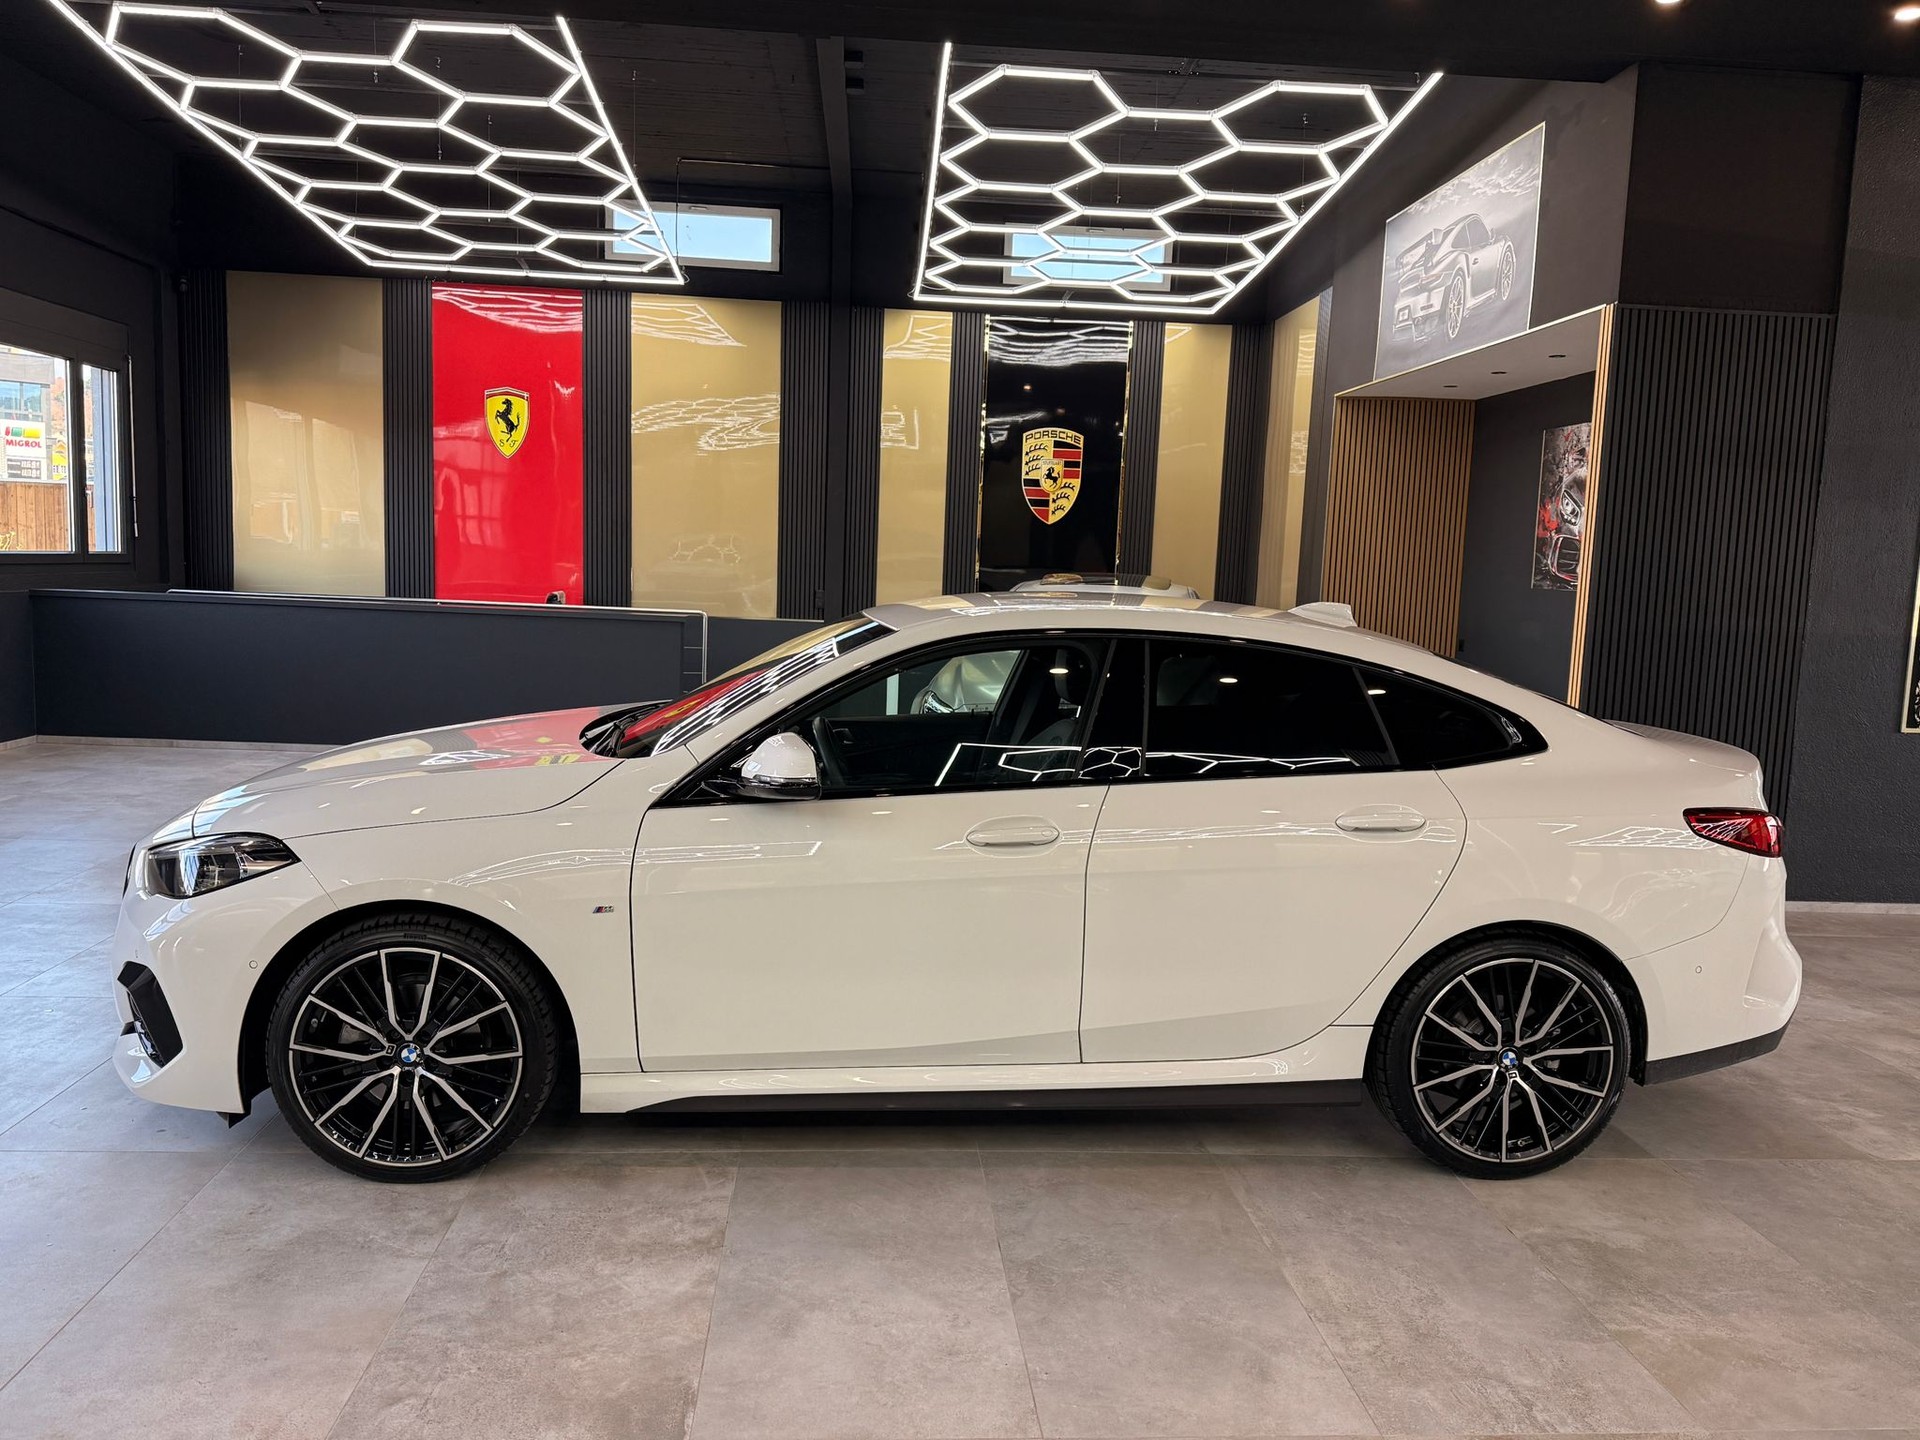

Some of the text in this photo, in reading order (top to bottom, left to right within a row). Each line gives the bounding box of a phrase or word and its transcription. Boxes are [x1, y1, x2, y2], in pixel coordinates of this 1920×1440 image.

[1025, 430, 1080, 444] PORSCHE
[5, 439, 42, 448] MIGROL
[499, 439, 505, 447] S
